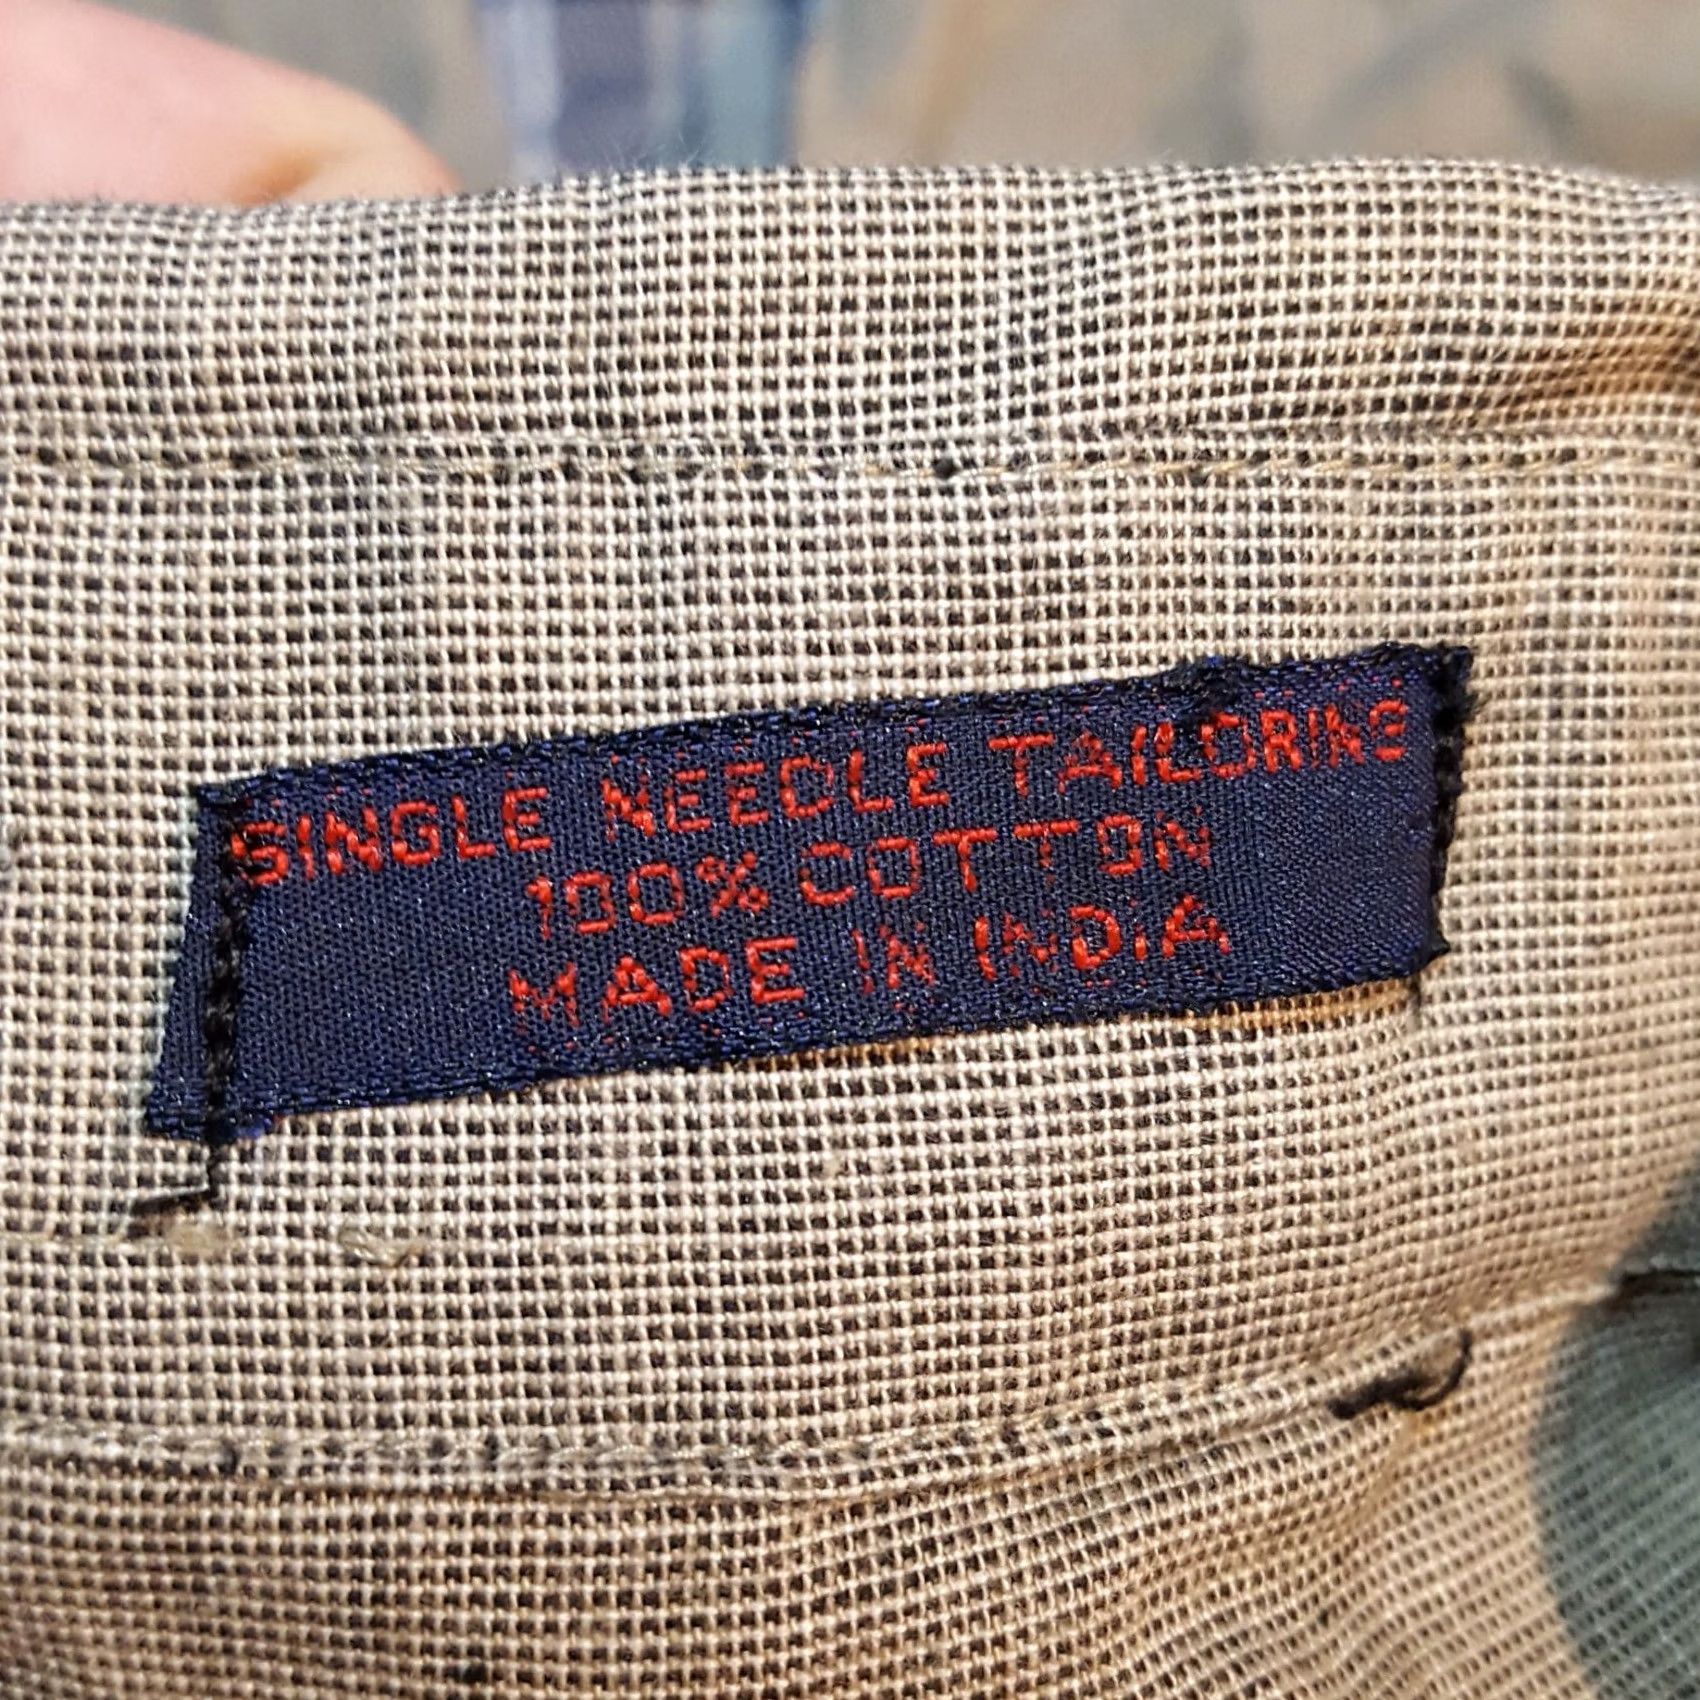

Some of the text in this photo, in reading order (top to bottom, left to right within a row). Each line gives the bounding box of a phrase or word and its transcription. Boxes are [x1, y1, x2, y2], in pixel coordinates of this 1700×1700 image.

[229, 787, 553, 887] SINGLE
[601, 742, 951, 840] NEEDLE
[525, 811, 1213, 939] 100% COTTON
[508, 894, 1231, 1030] MADE IN INDIA
